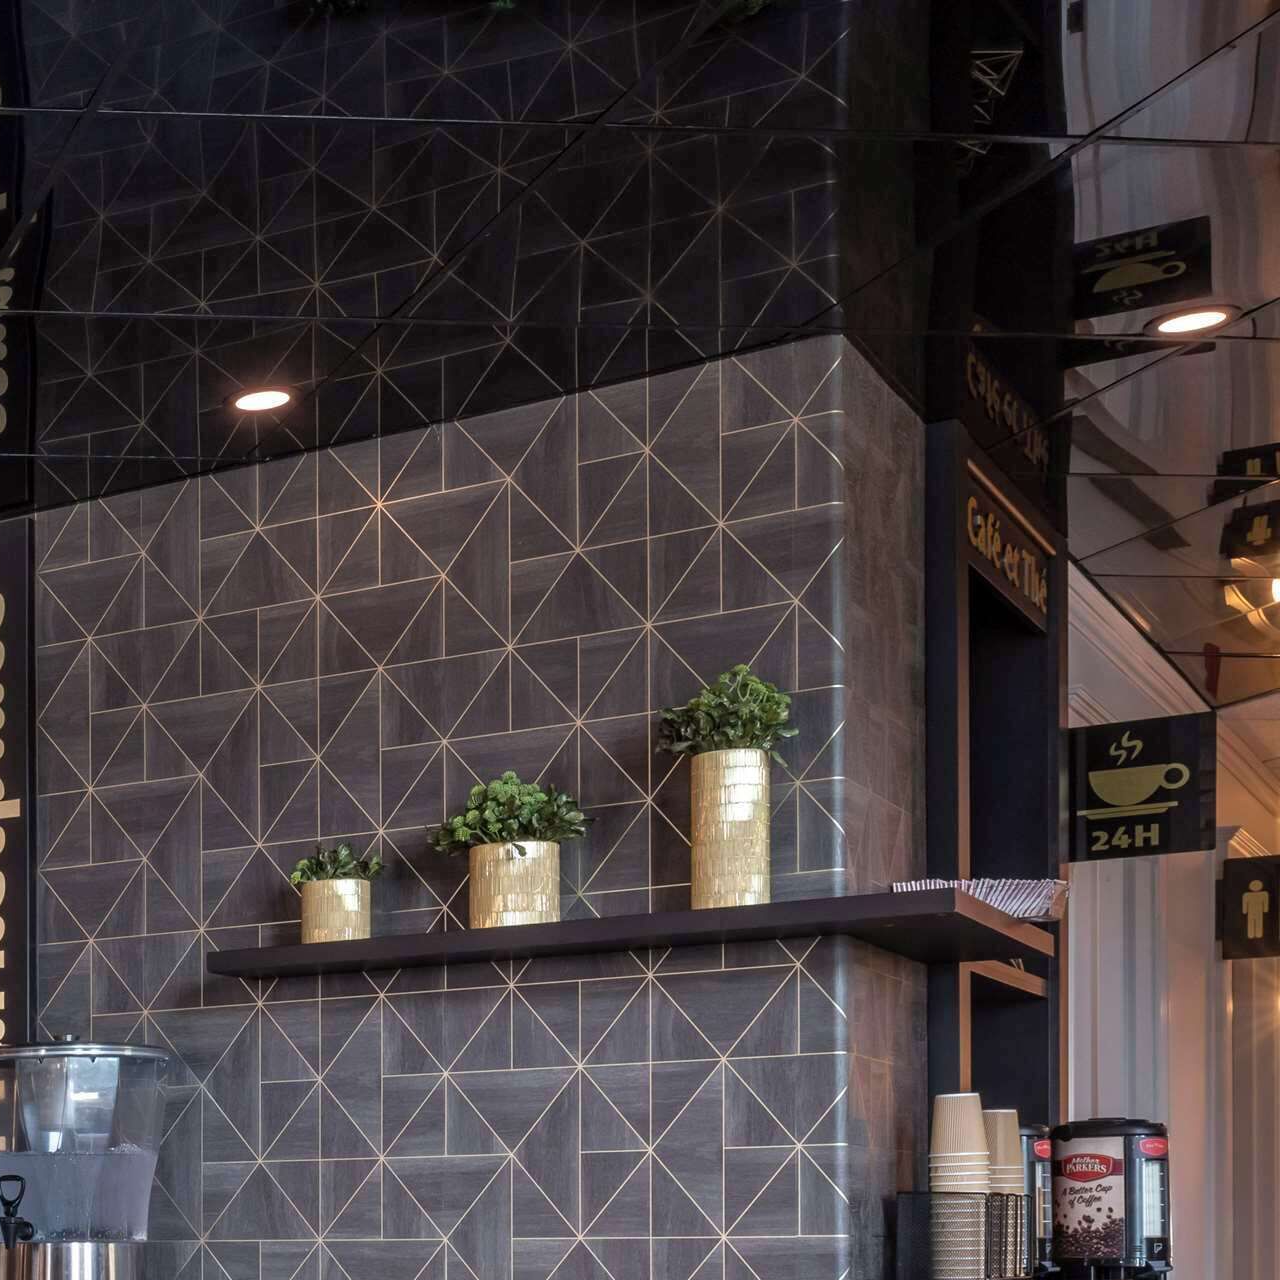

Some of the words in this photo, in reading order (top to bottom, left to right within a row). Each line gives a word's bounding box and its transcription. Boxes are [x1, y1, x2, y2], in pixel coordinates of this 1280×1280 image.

[968, 496, 1001, 569] Café
[1091, 823, 1160, 851] 24H
[1066, 1163, 1107, 1174] PARKERS
